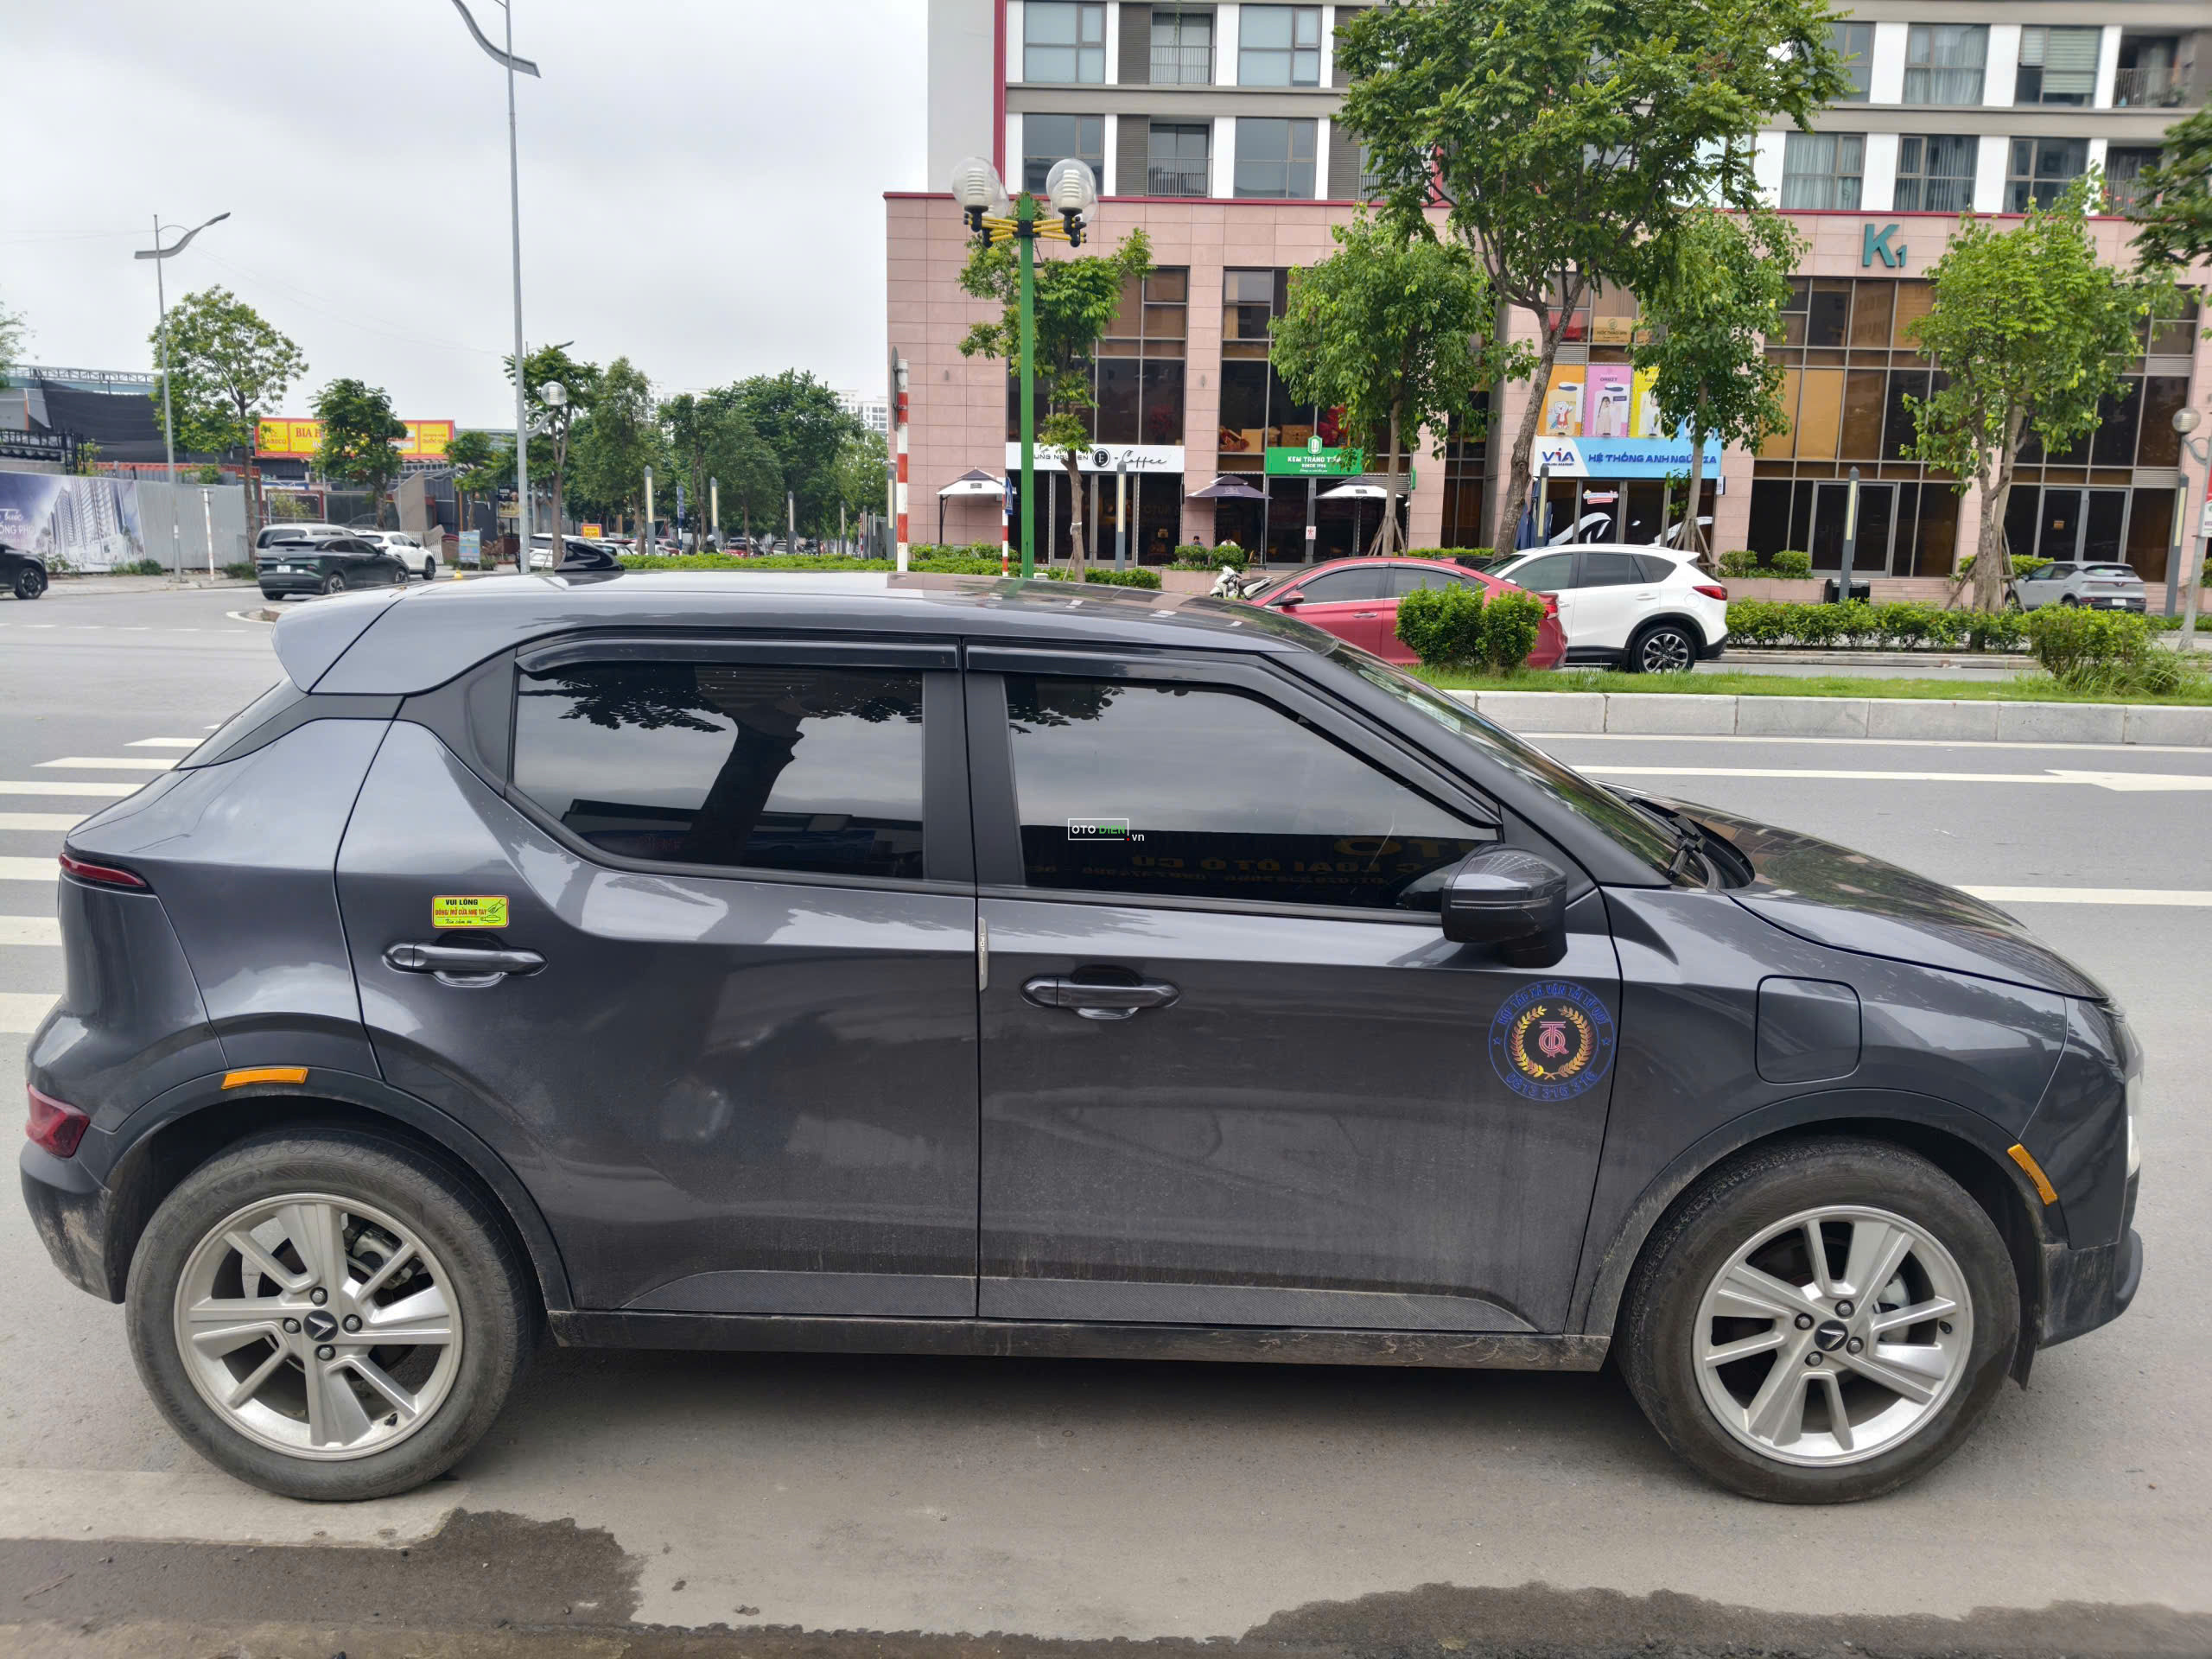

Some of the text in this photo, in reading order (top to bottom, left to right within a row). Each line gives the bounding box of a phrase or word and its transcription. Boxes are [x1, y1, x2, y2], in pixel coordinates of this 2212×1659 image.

[1862, 223, 1908, 268] K1
[296, 428, 312, 437] BIA
[1122, 449, 1167, 468] Coffee
[1645, 454, 1669, 463] ANH
[1702, 455, 1717, 464] IA
